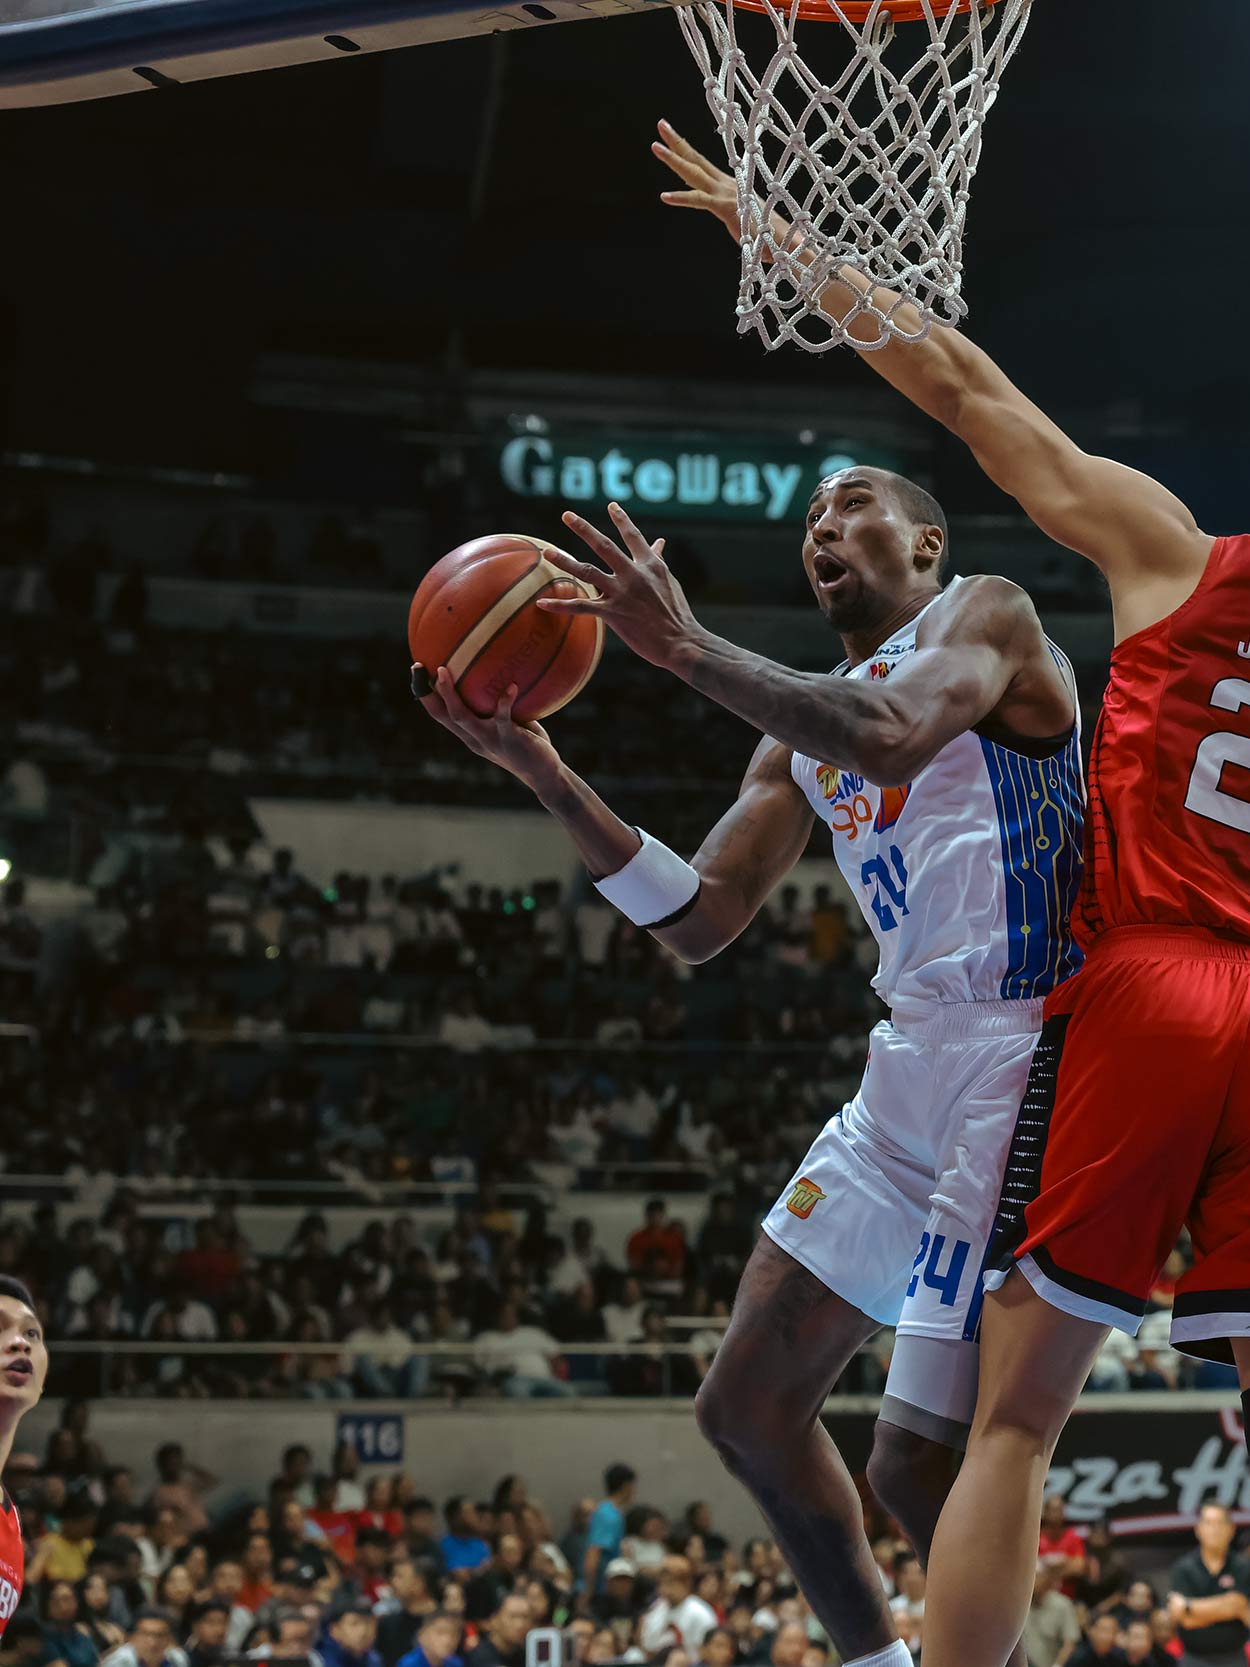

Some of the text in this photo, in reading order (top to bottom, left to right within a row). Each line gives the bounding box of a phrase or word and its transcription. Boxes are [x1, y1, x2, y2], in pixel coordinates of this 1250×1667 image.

[786, 1182, 828, 1213] TNT
[905, 1231, 972, 1307] 24
[1043, 1456, 1169, 1520] zza
